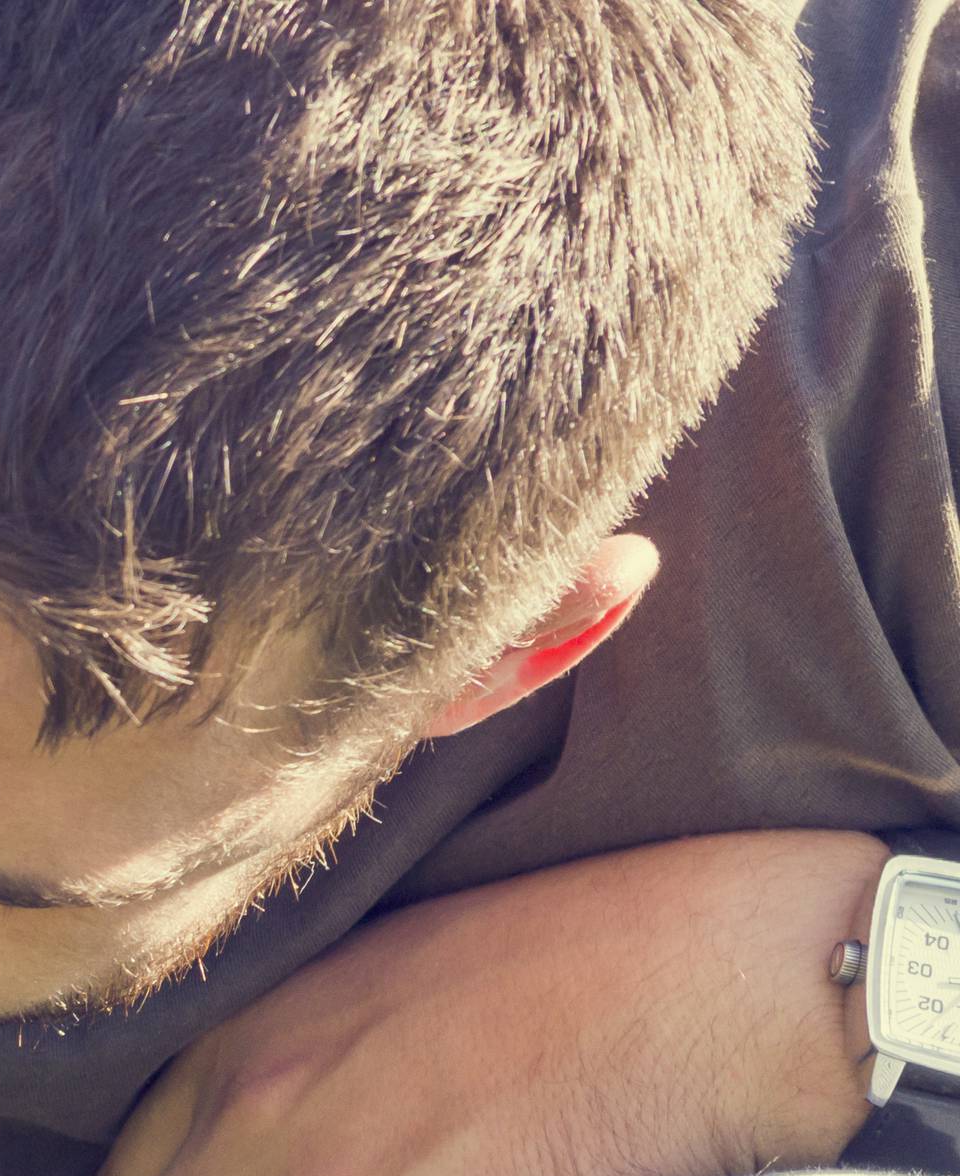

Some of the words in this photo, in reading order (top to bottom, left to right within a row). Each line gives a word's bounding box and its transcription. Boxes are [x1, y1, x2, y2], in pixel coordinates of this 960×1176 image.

[924, 932, 949, 950] 04
[907, 960, 932, 978] 03
[918, 995, 944, 1014] 02
